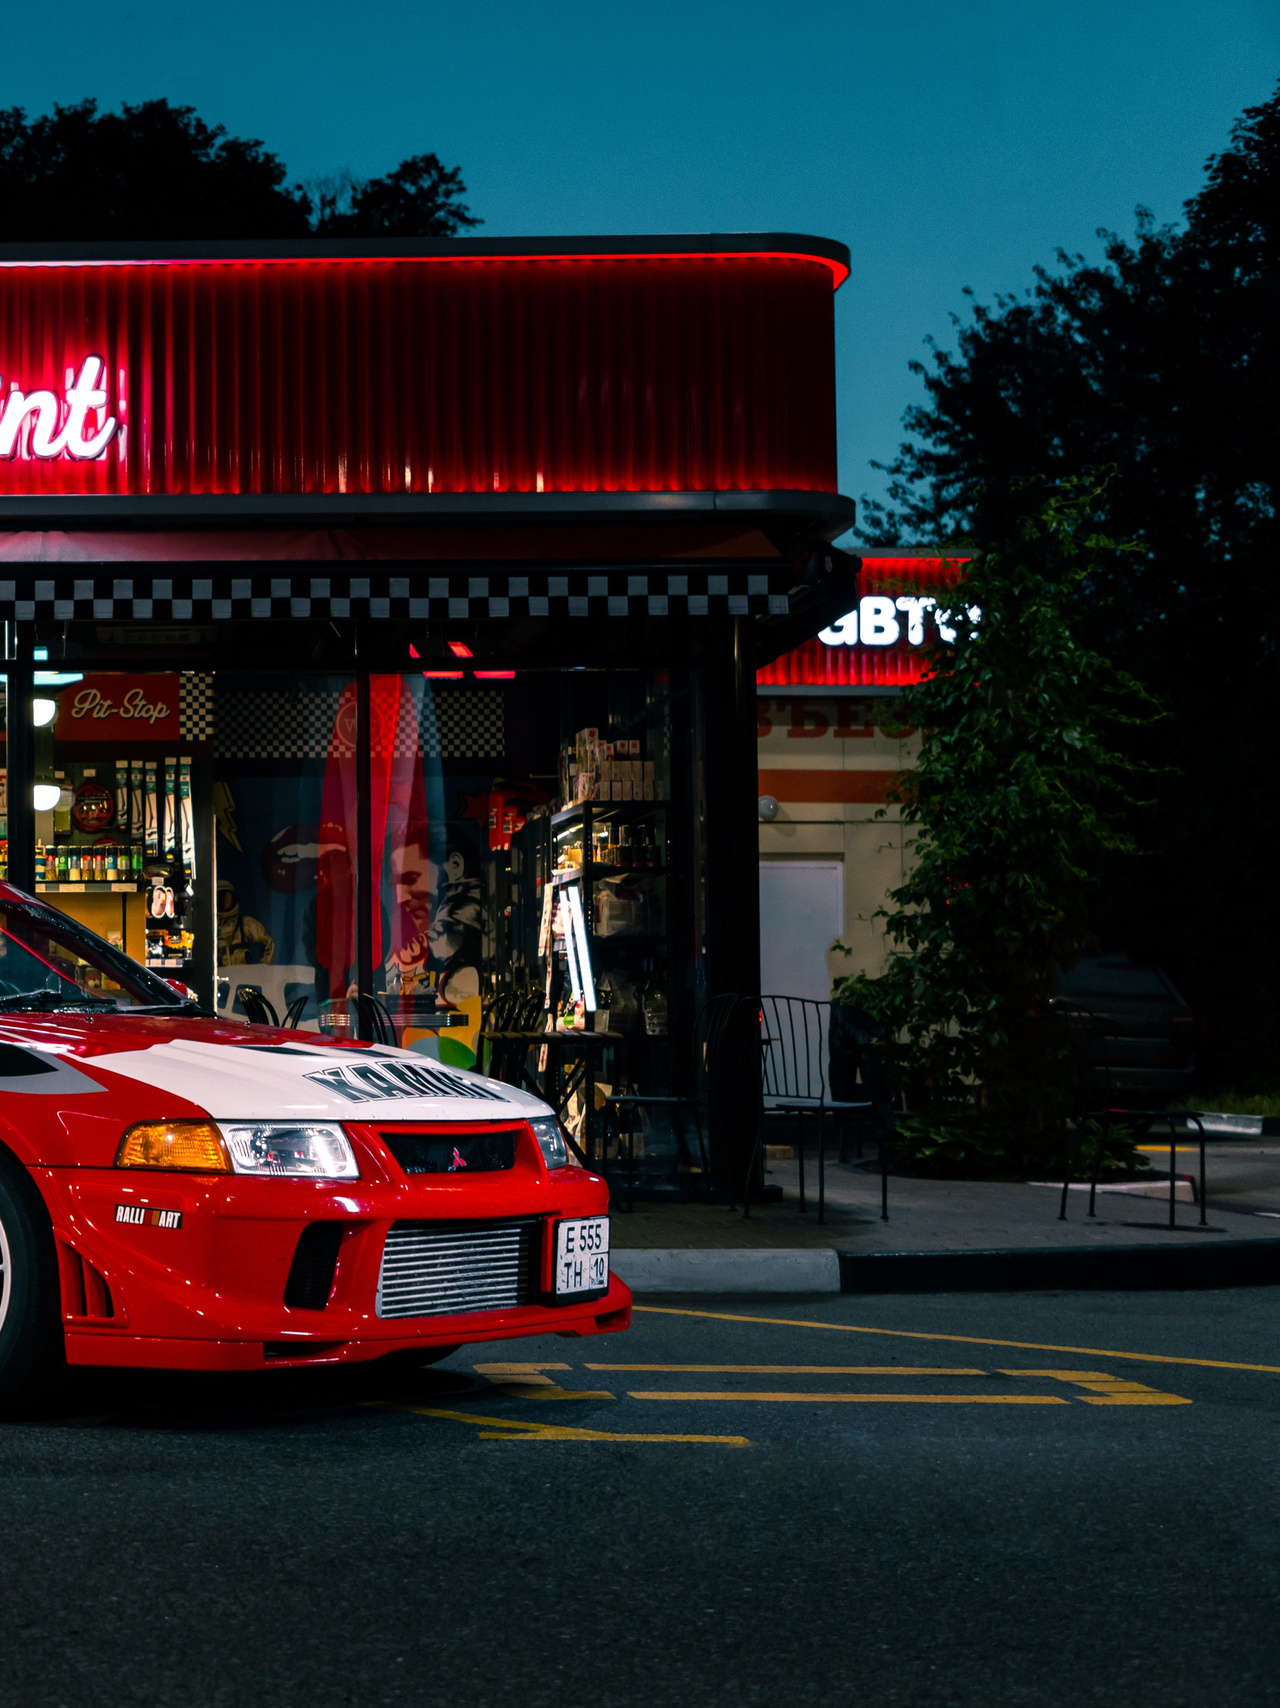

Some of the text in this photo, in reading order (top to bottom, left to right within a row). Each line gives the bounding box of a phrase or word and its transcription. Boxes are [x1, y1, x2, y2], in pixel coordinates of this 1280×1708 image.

[71, 688, 170, 725] Pit-Stop
[579, 1223, 602, 1252] 555
[593, 1257, 605, 1278] 10
